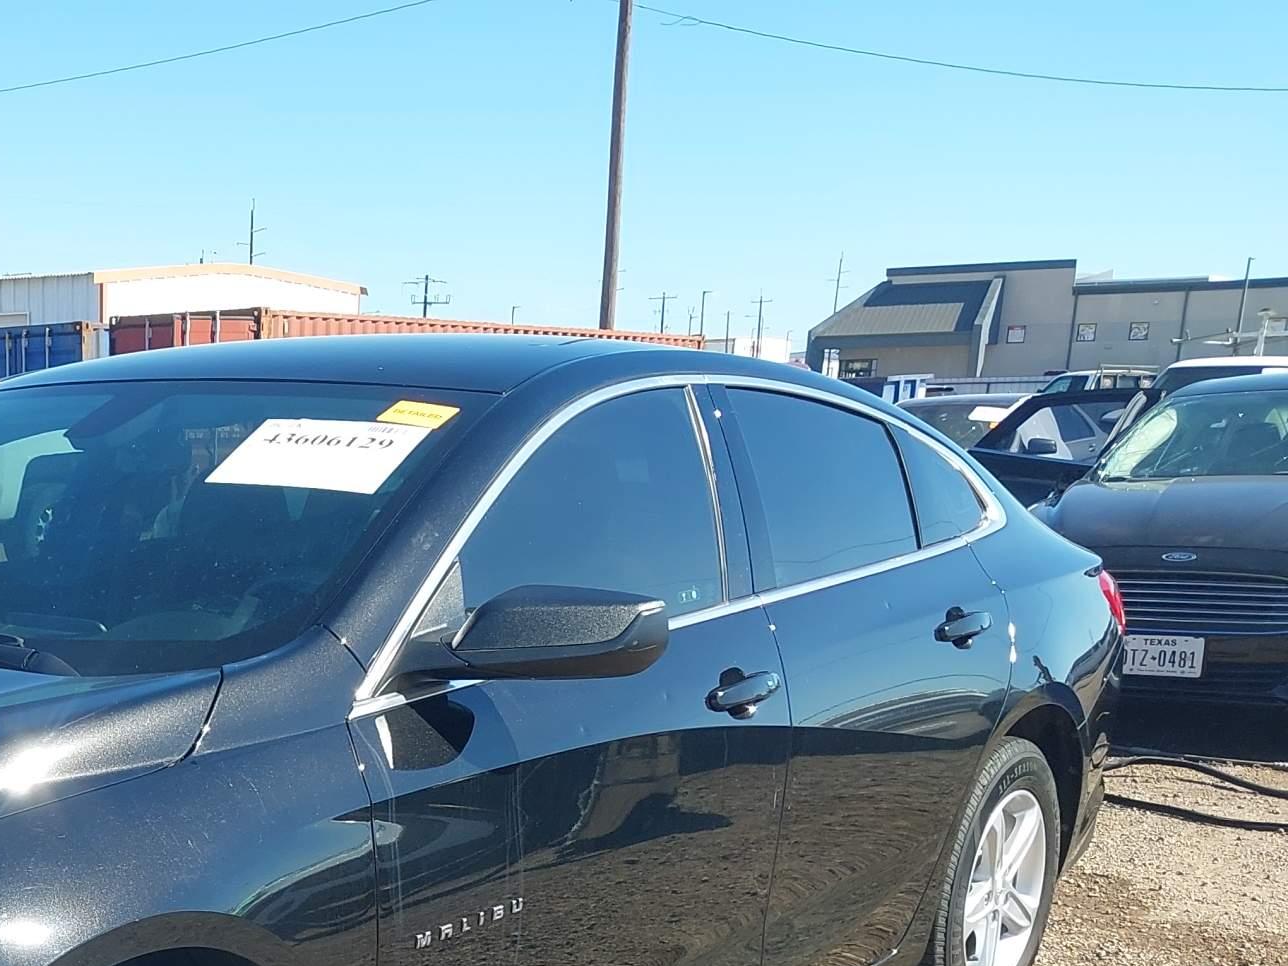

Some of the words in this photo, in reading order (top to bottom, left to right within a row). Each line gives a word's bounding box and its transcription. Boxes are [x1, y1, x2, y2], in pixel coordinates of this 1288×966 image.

[393, 408, 443, 419] DETAILED
[264, 433, 394, 449] 43606129
[1144, 638, 1177, 646] TEXAS
[415, 897, 524, 950] MALIBU
